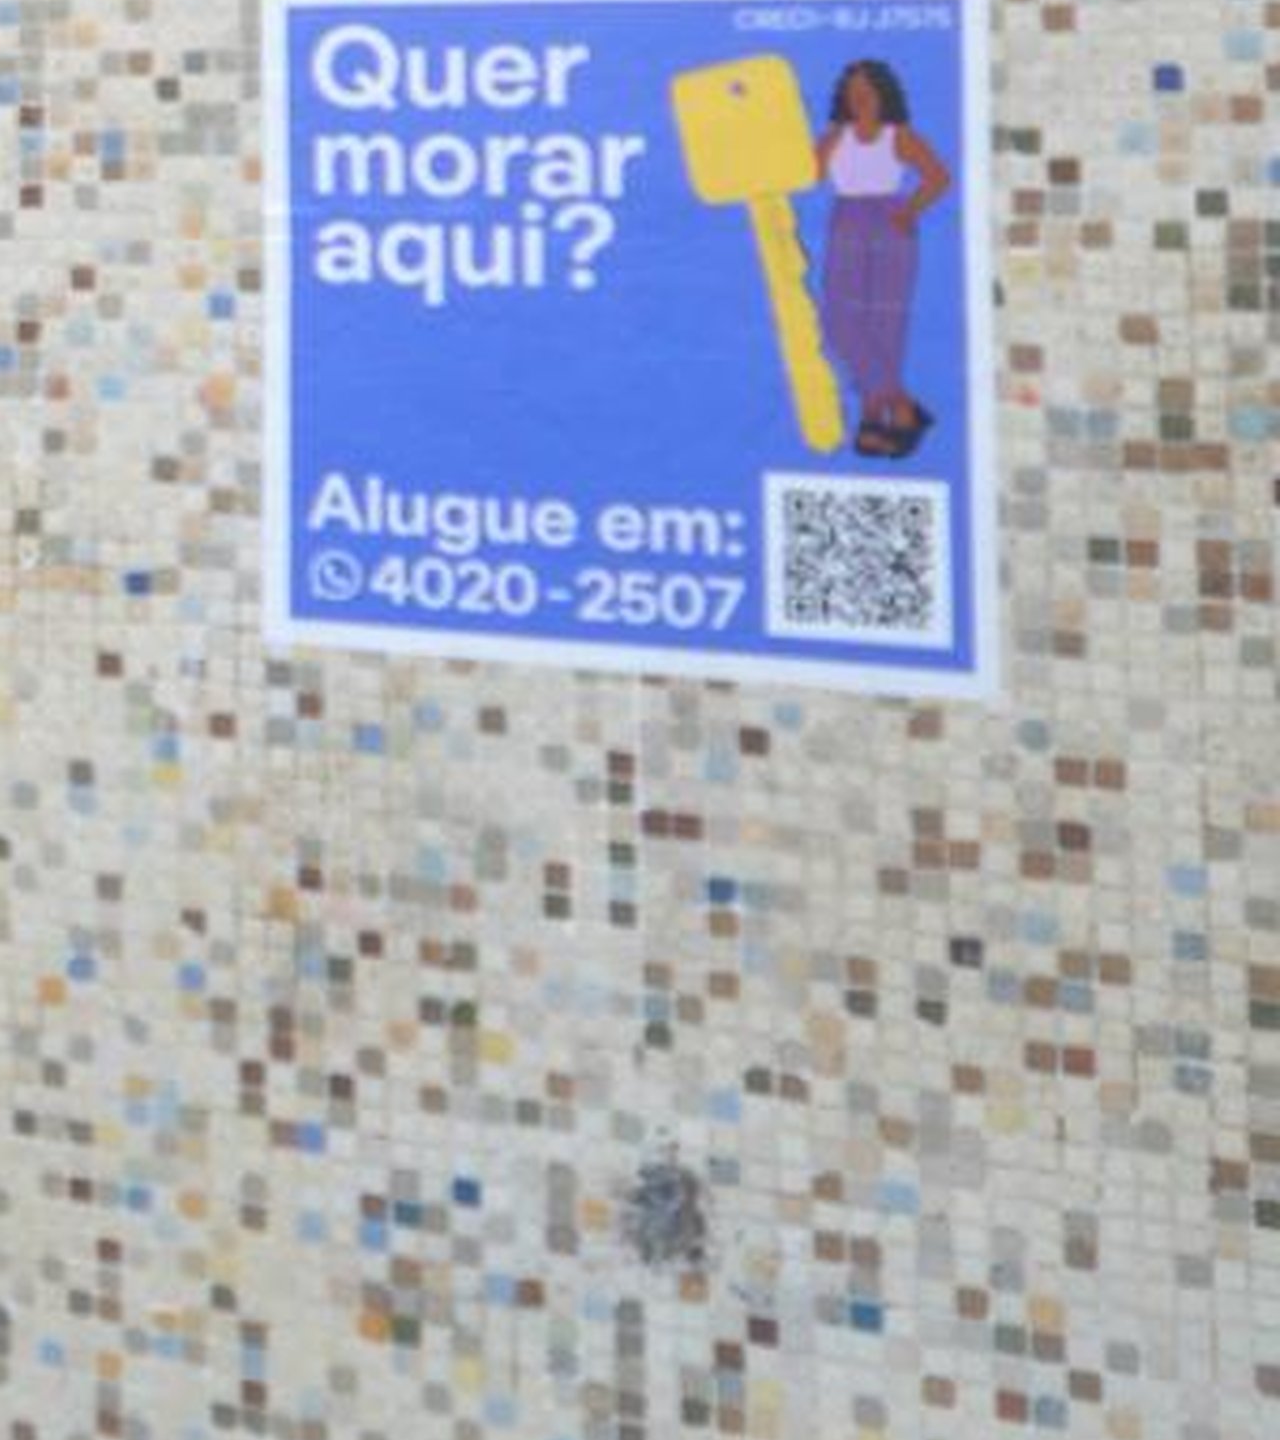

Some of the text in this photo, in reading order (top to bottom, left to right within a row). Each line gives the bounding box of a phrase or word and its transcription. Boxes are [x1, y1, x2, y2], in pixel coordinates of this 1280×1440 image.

[312, 24, 589, 110] Quer
[313, 132, 645, 200] morar
[315, 201, 616, 306] aqui?
[309, 472, 746, 558] Alugue em:
